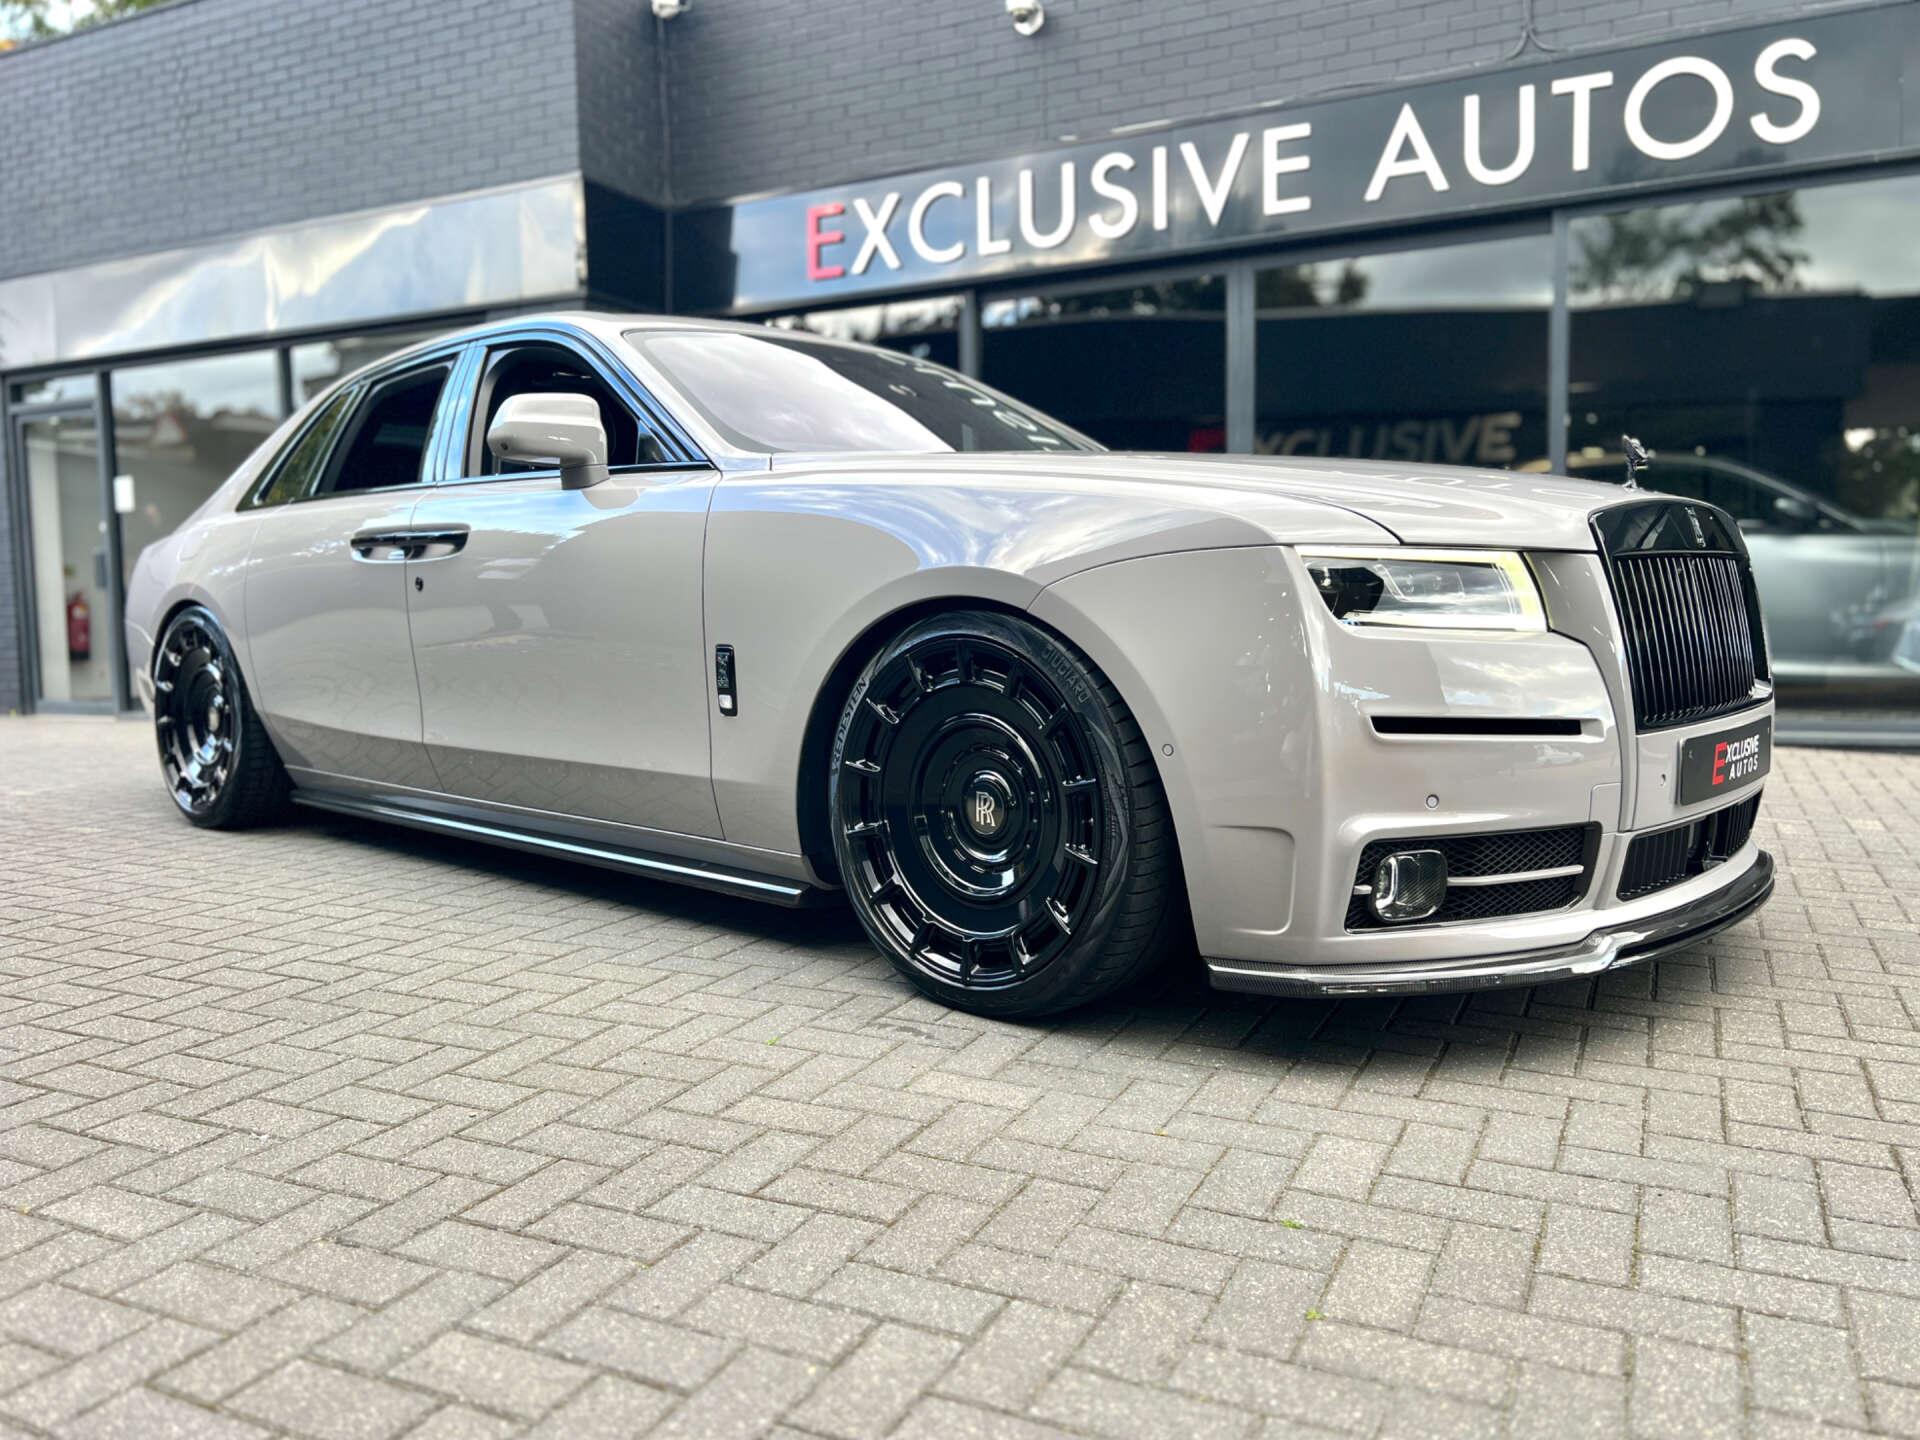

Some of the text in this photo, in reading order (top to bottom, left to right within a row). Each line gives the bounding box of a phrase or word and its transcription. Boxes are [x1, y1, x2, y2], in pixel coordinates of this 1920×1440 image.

[805, 37, 1822, 282] EXCLUSIVE AUTOS
[1711, 734, 1760, 786] EXCLUSIVE
[1728, 754, 1759, 780] AUTOS
